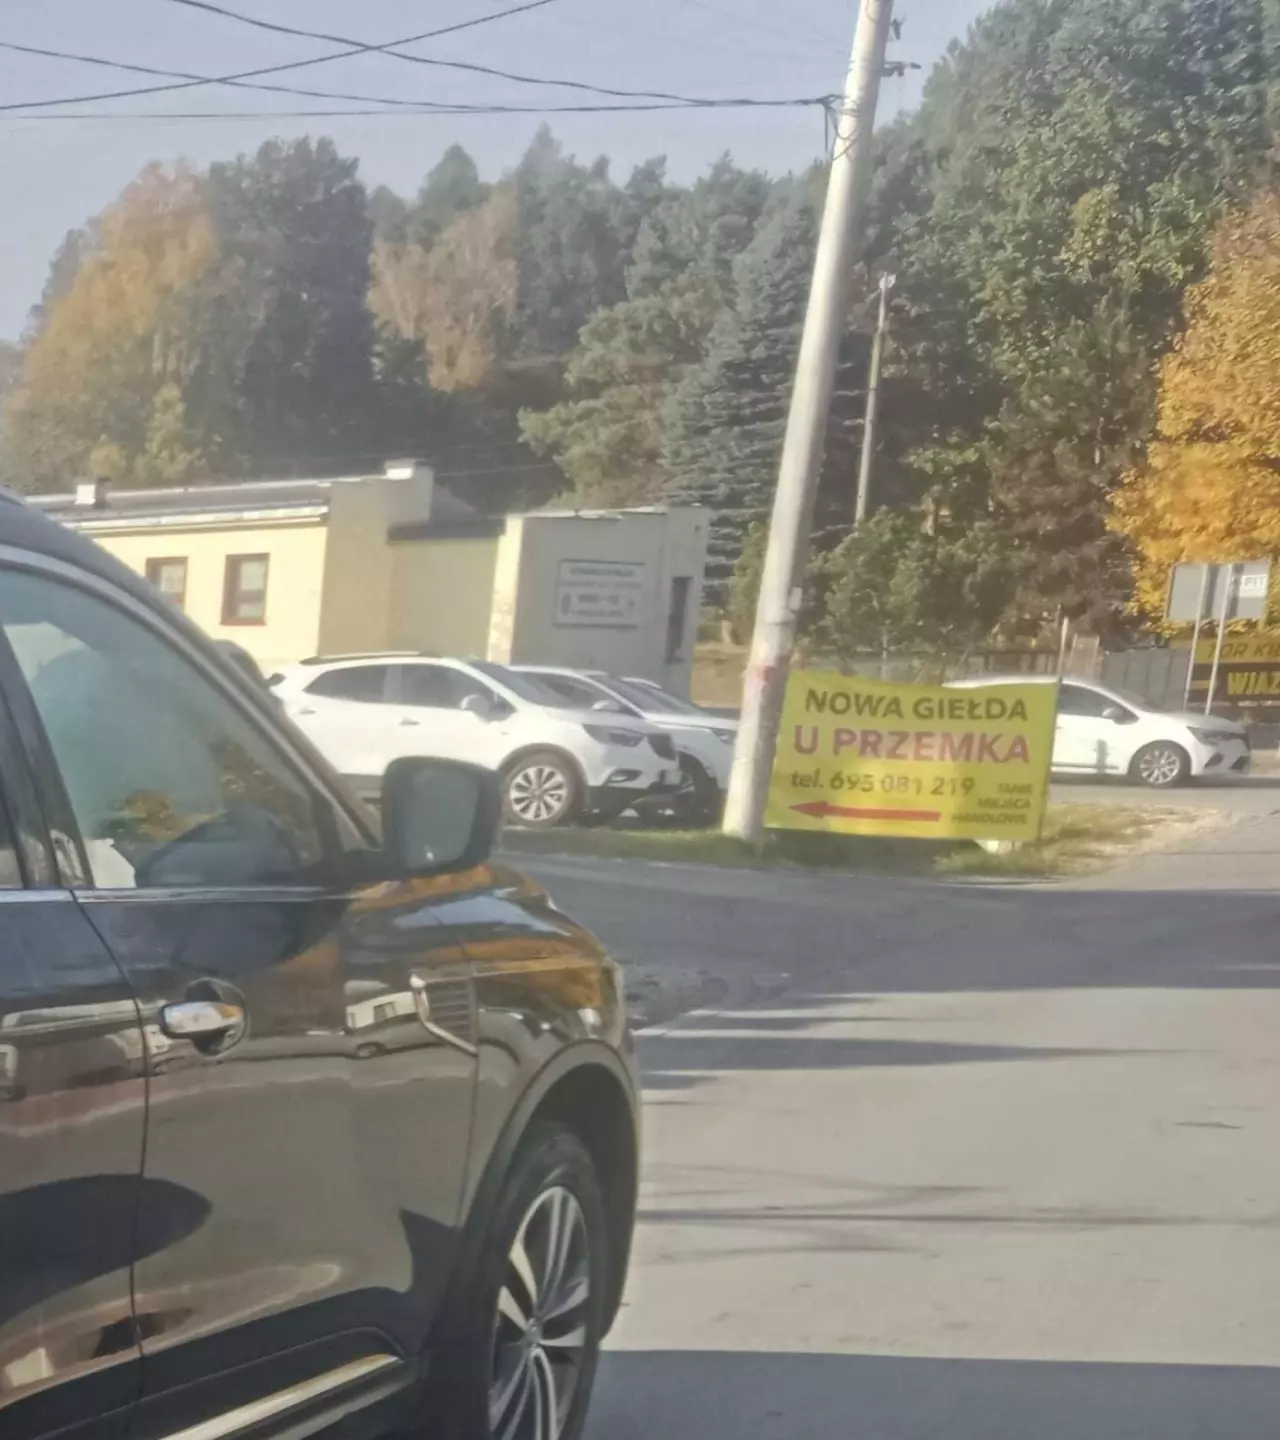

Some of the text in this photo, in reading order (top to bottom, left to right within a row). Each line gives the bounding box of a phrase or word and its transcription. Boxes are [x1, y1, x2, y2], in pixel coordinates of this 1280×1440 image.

[804, 688, 1029, 721] NOWA GIEŁDA
[793, 724, 1030, 764] U PRZEMKA
[791, 768, 976, 797] tel. 695 081 219
